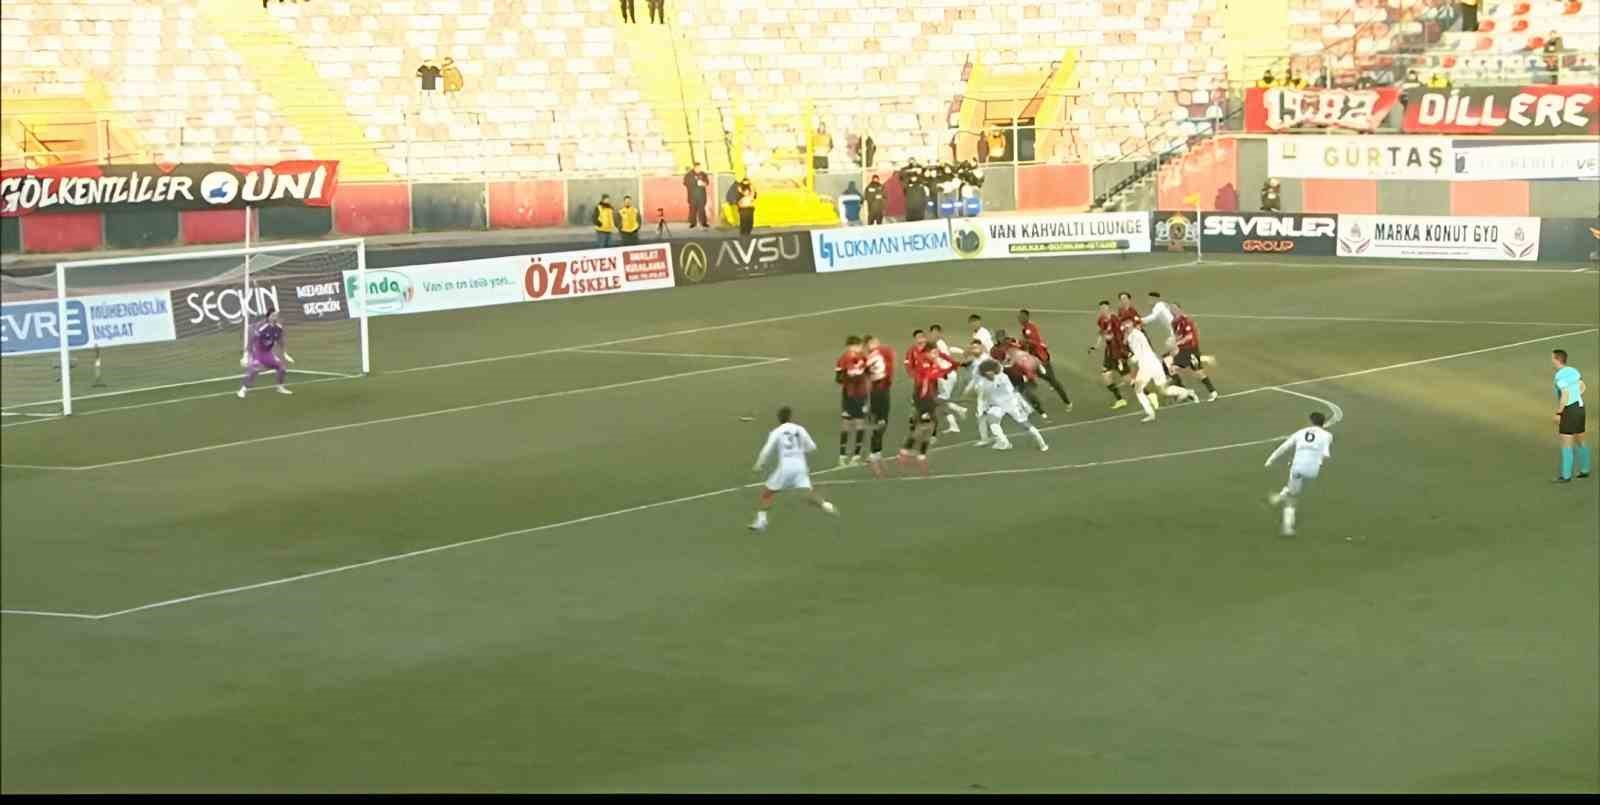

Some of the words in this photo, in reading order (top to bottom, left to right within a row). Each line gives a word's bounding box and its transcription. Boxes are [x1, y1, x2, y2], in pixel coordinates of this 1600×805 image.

[1418, 89, 1593, 127] DİLLERE
[1323, 141, 1443, 174] GÜRTAŞ
[989, 224, 1016, 239] VAN
[1021, 221, 1084, 238] KAHVALTI
[1090, 219, 1142, 235] LOUNGE
[1204, 215, 1336, 238] SEVENLER
[1375, 223, 1420, 241] MARKA
[1425, 224, 1468, 242] KONUT
[1474, 225, 1498, 243] GYO
[716, 234, 800, 266] AVSU
[835, 237, 898, 258] LOKMAN
[1242, 239, 1295, 252] GROUP
[570, 256, 617, 274] GÜVEN
[525, 257, 570, 298] ÖZ
[783, 431, 800, 449] 31
[1305, 431, 1315, 443] 6
